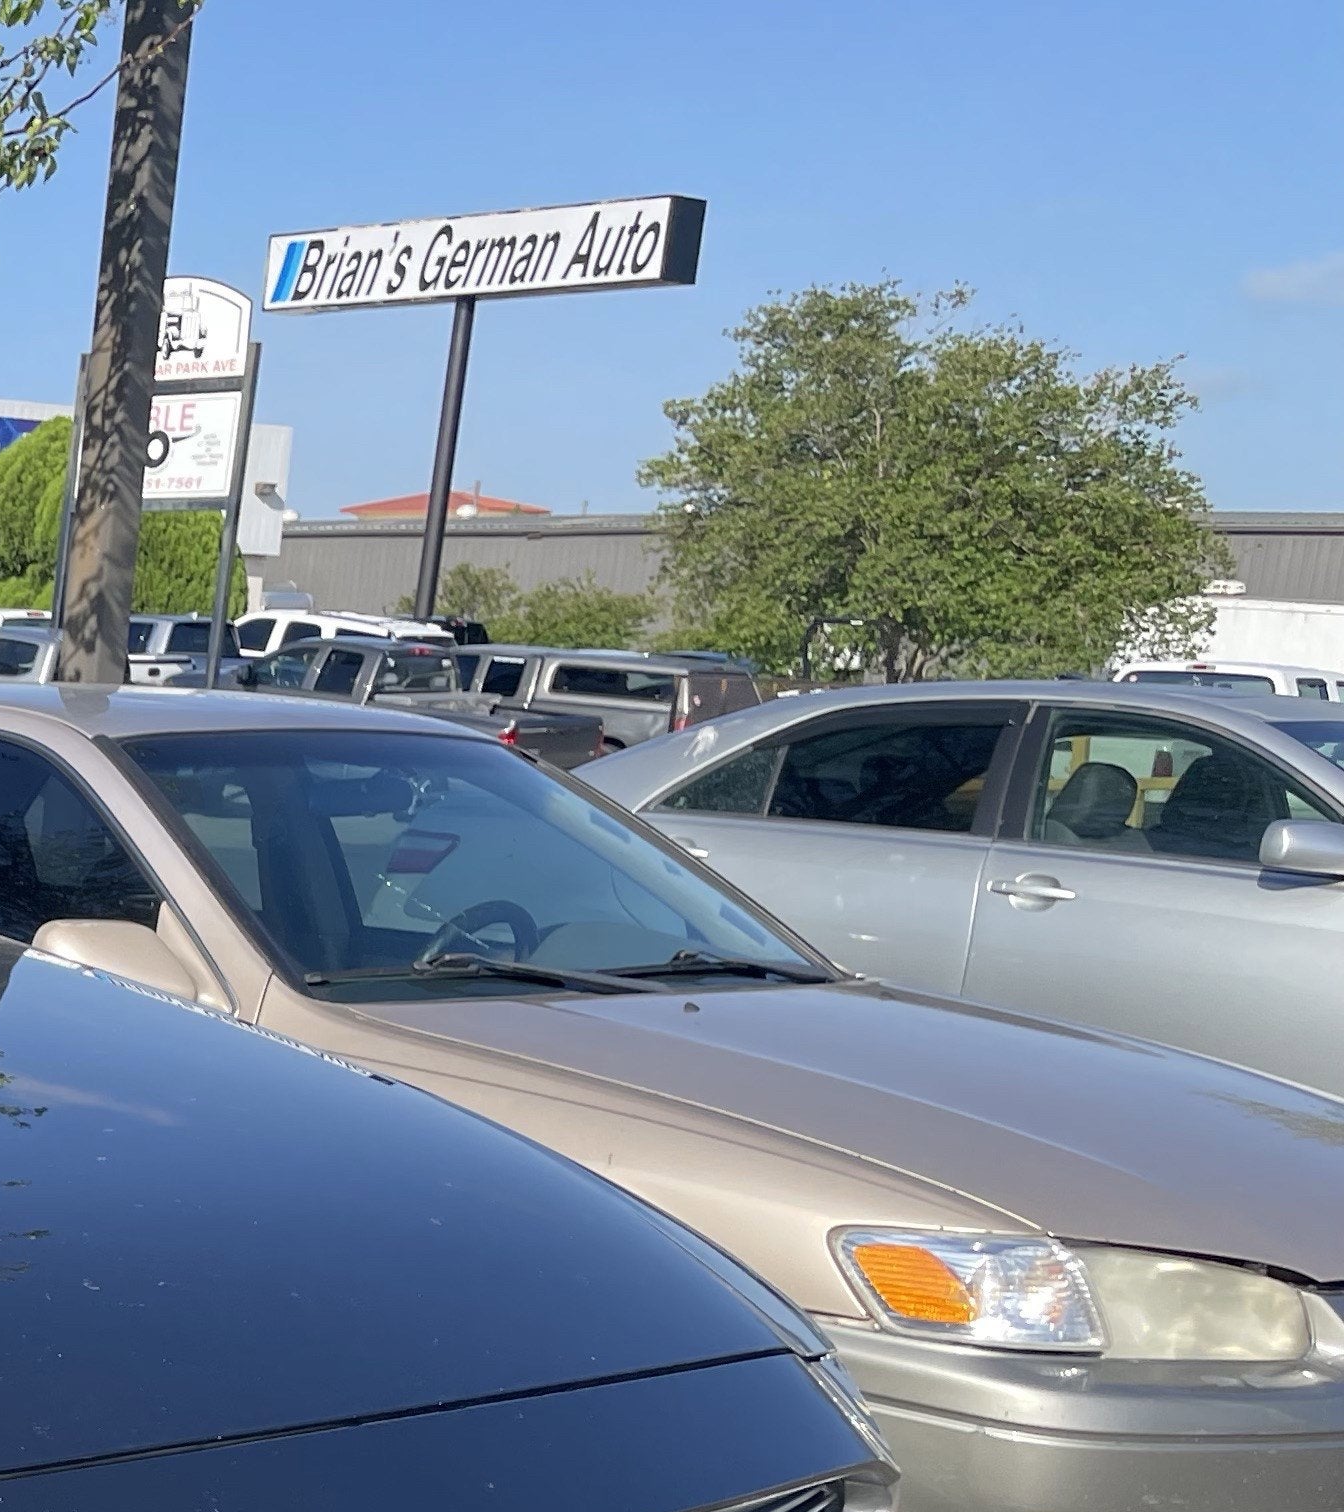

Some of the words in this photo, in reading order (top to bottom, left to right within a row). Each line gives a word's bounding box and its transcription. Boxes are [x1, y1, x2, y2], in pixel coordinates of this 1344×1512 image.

[291, 231, 413, 301] Brian's
[419, 224, 561, 292] German
[562, 210, 661, 280] Auto
[176, 362, 208, 373] PARK
[213, 359, 237, 372] AVE
